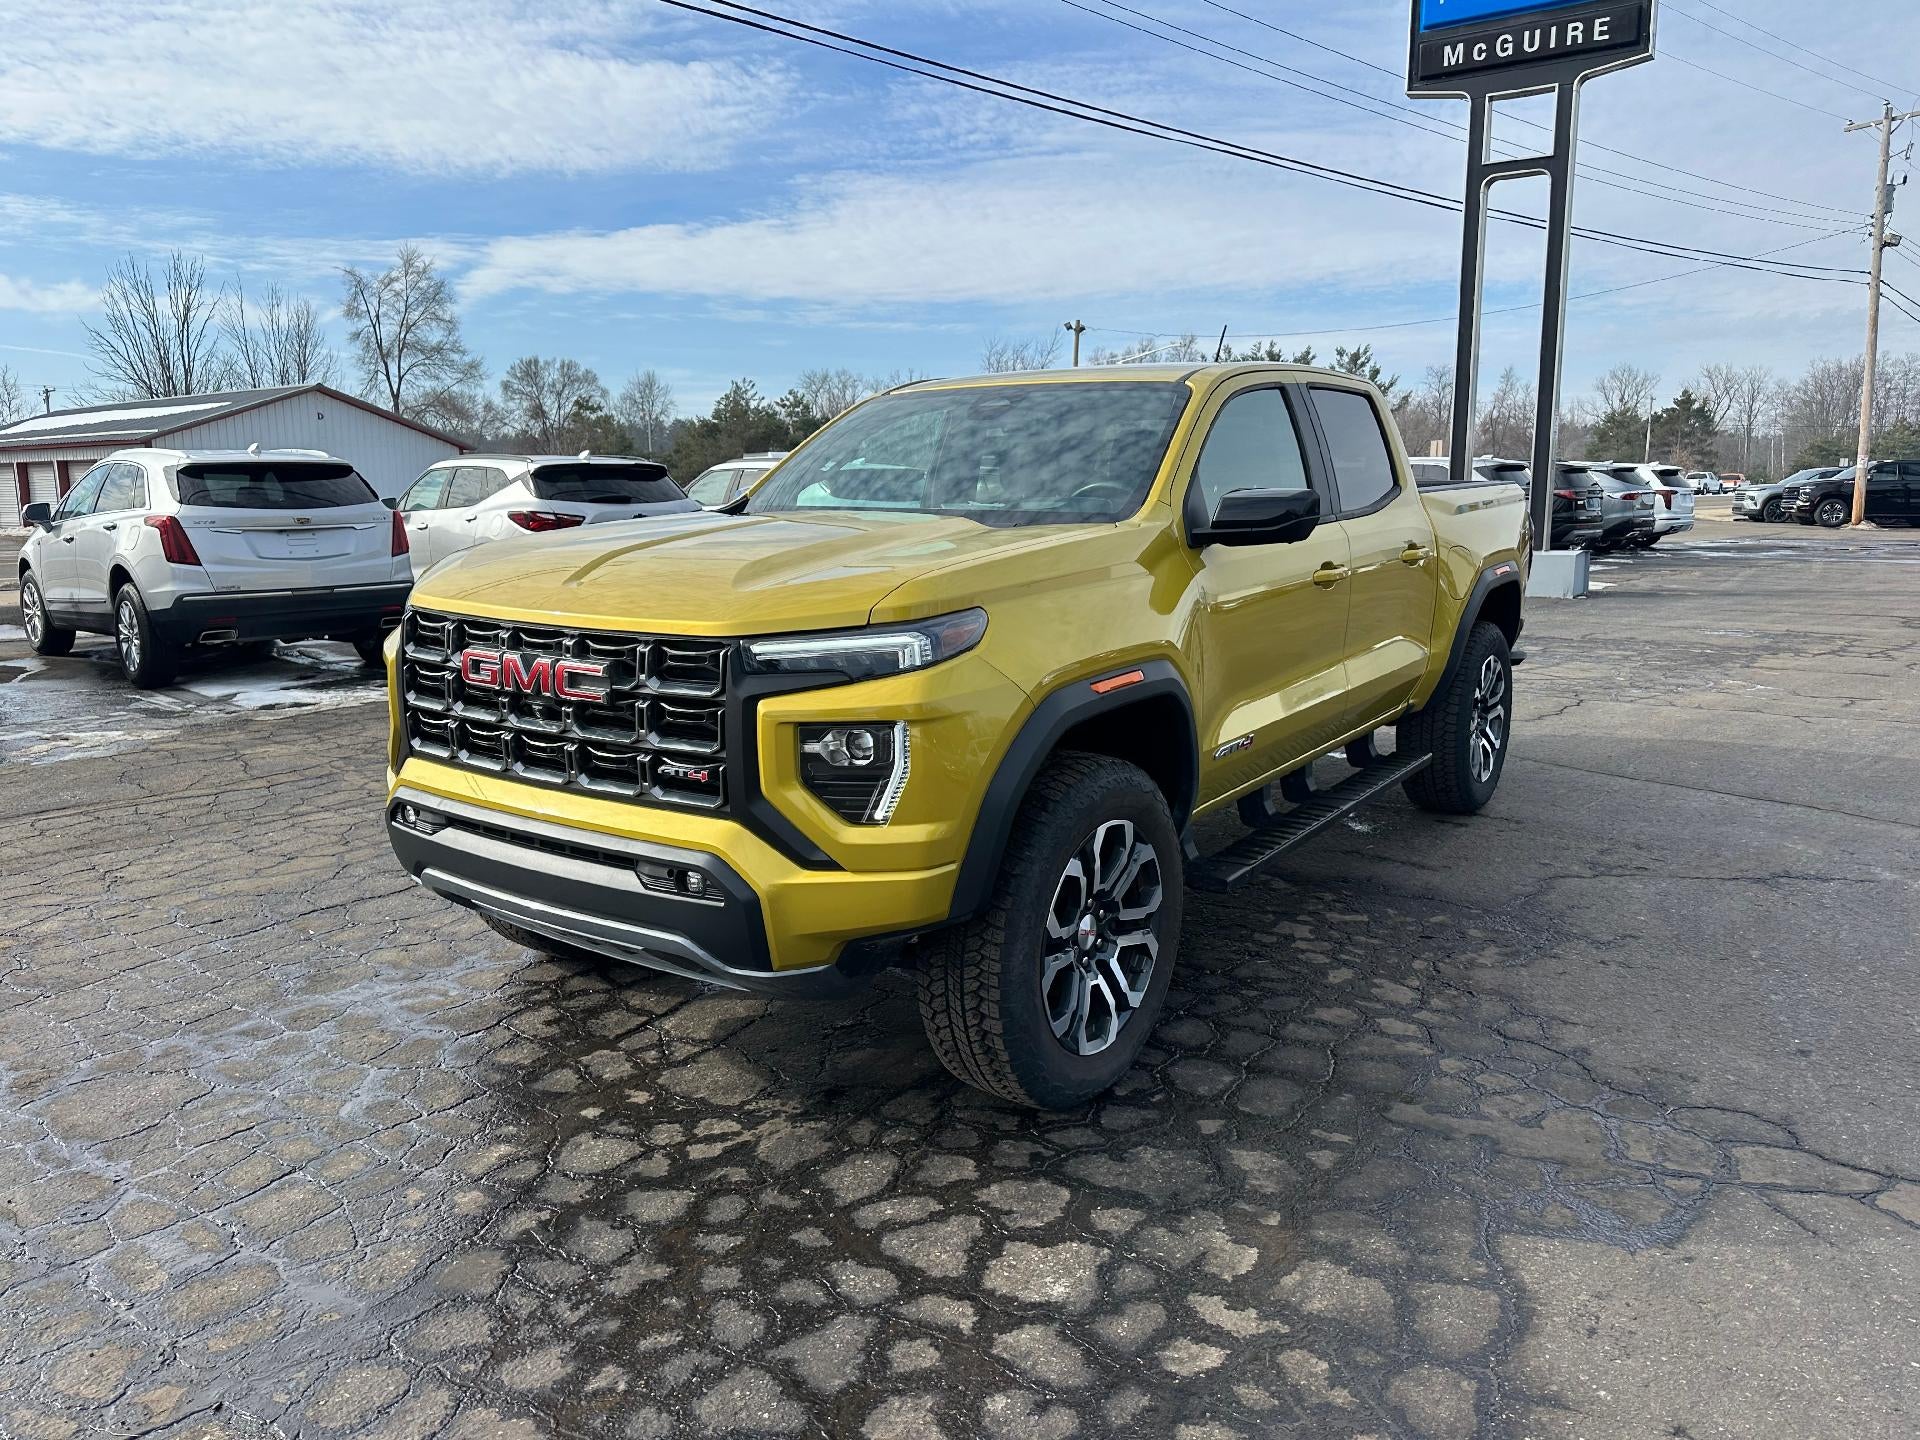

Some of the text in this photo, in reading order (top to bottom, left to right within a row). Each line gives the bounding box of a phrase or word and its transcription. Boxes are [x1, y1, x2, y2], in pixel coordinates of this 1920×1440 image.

[1443, 17, 1611, 67] McGUIRE
[317, 412, 324, 420] D
[460, 649, 610, 704] GMC
[657, 764, 709, 783] AT4
